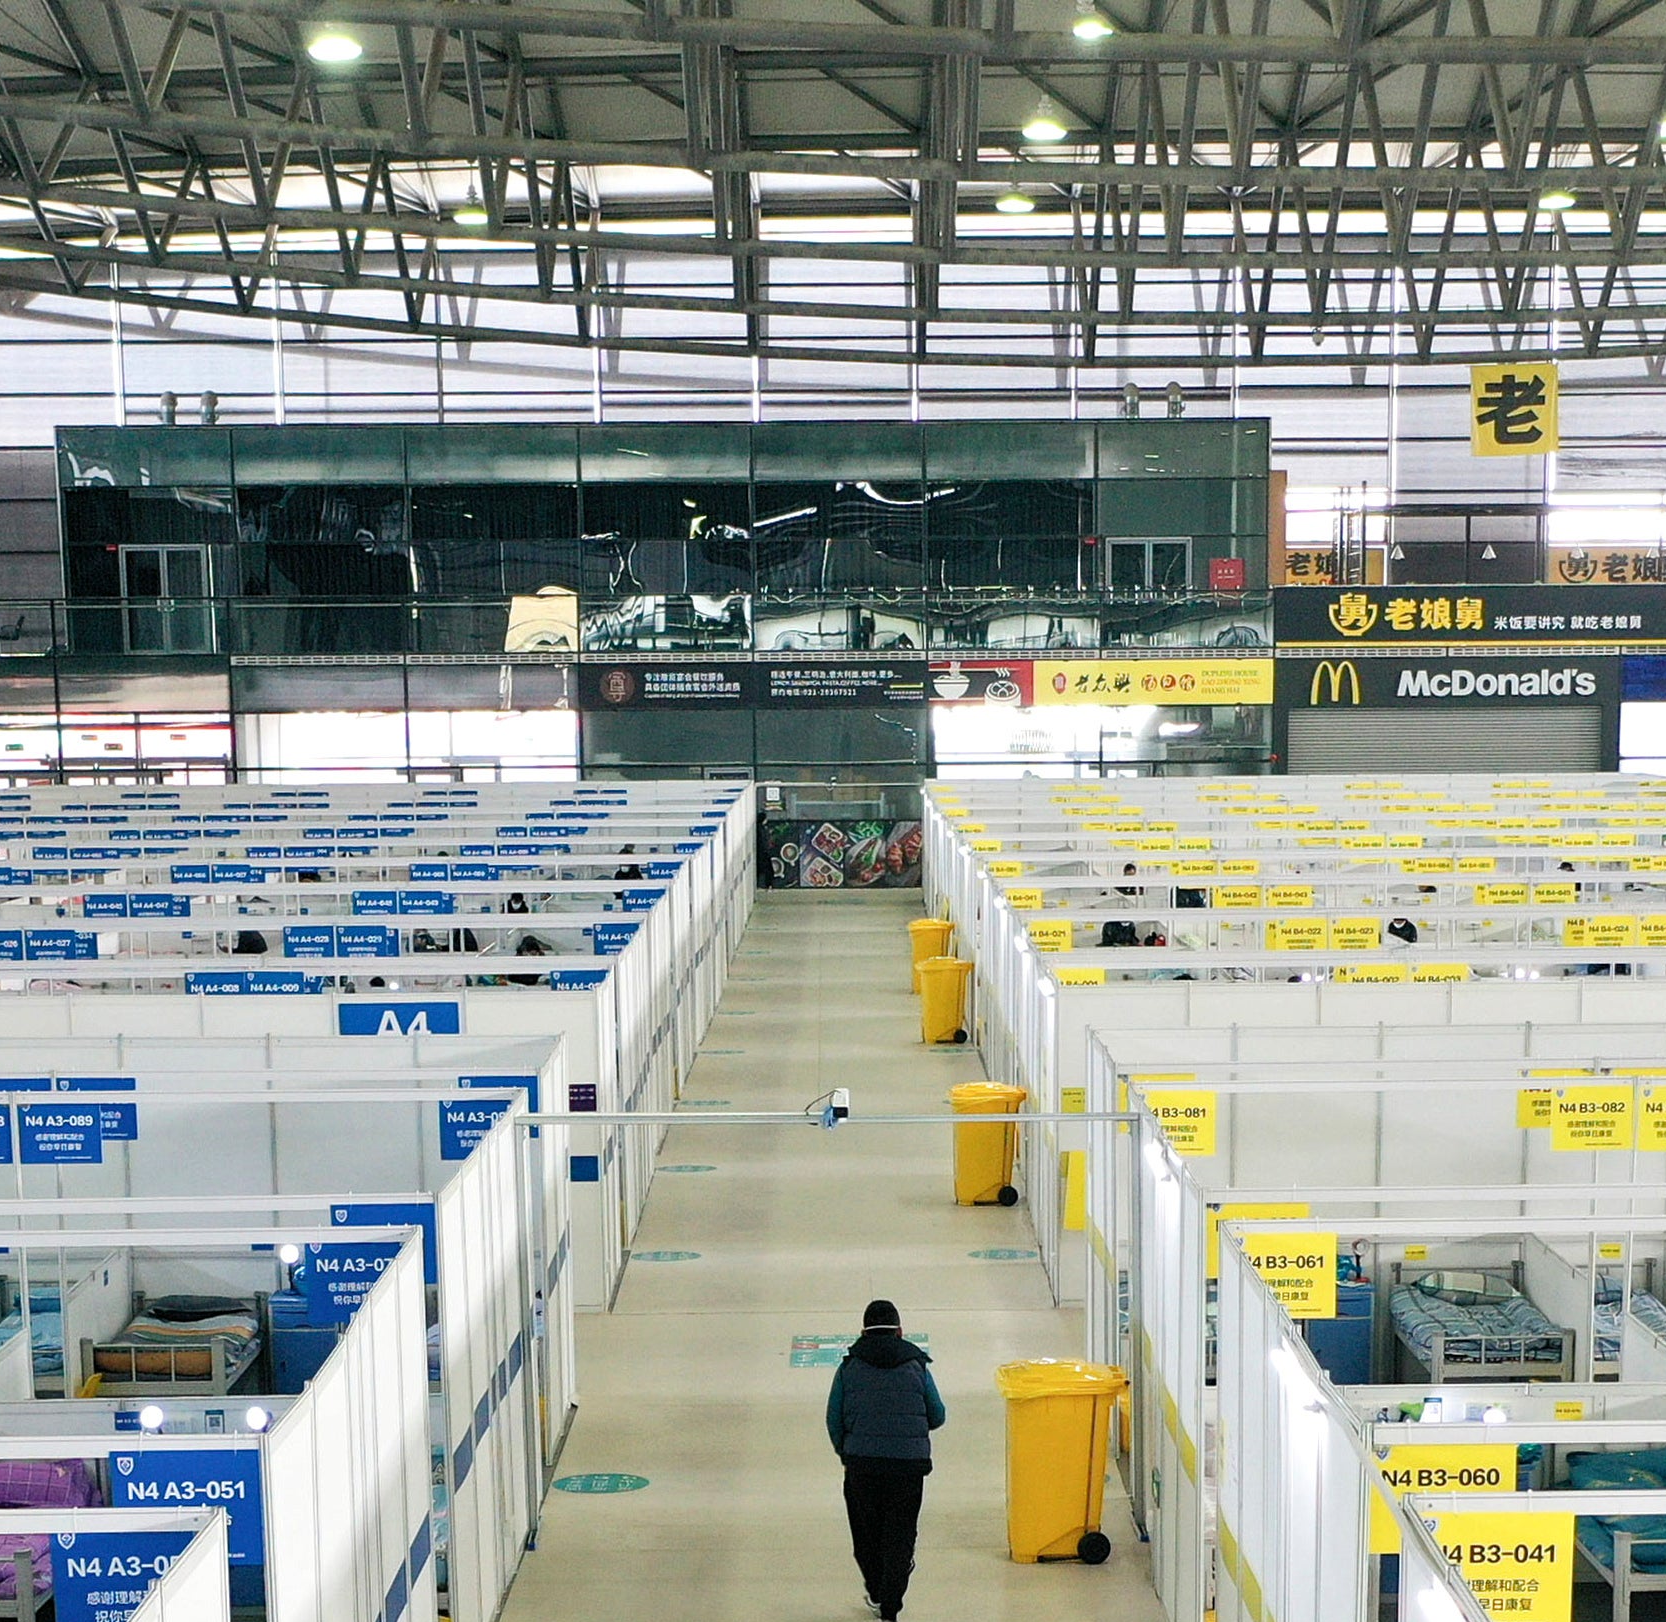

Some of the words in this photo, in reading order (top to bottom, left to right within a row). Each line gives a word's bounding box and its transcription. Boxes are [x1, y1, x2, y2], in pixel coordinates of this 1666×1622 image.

[1476, 375, 1545, 444] 老
[1385, 597, 1485, 630] 老娘舅
[1494, 616, 1565, 630] 米饭要讲究
[1570, 616, 1642, 630] 就吃老娘舅
[1397, 668, 1597, 696] McDonald's
[377, 1010, 432, 1036] A4
[128, 1482, 159, 1500] N4
[164, 1481, 244, 1499] A3-051
[1382, 1470, 1412, 1486] N4
[1418, 1469, 1499, 1486] B3-060
[1470, 1545, 1554, 1563] B3-041
